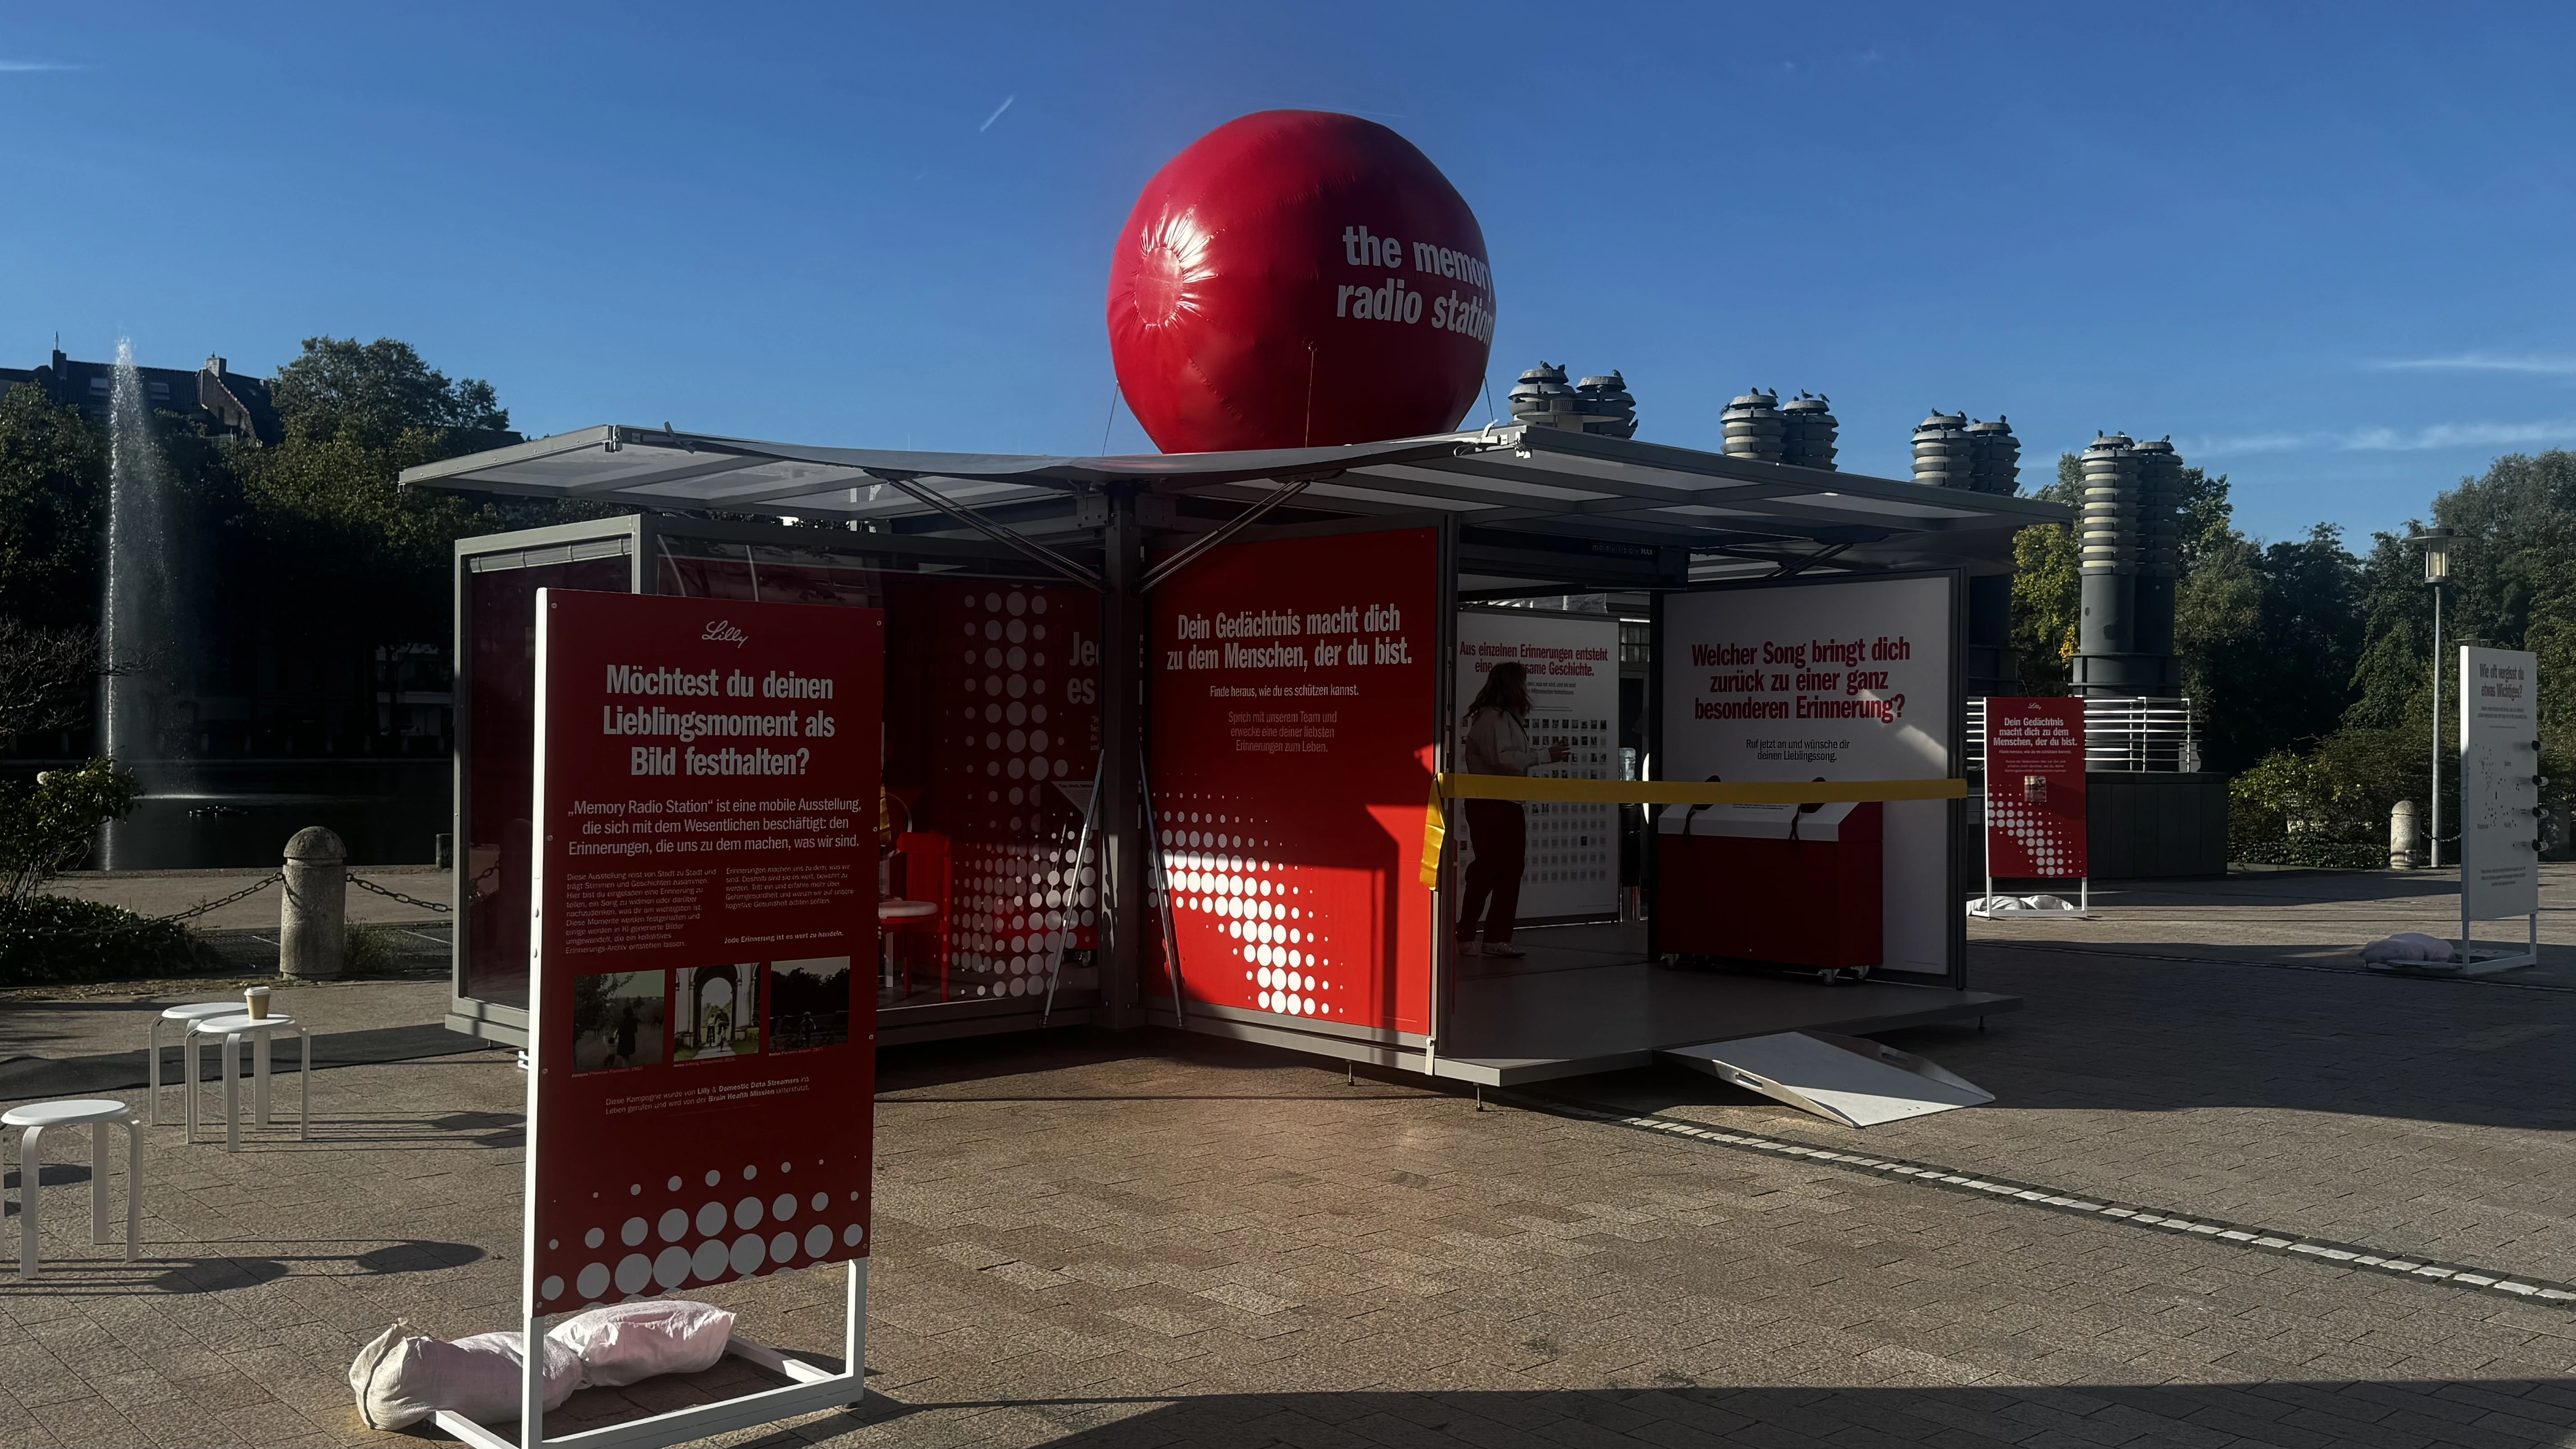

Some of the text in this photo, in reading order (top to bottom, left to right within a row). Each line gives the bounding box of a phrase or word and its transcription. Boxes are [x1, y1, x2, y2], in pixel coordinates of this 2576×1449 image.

[1343, 225, 1402, 268] the
[1337, 278, 1492, 346] radio station
[1178, 603, 1400, 639] Dein Gedächtnis macht dich
[702, 621, 748, 648] Lilly
[1070, 632, 1099, 666] Je
[1167, 637, 1412, 672] zu dem Menschen, der du bist.
[1460, 641, 1608, 662] Aus einzelnen Erinnerungen entsteht
[1692, 636, 1910, 669] Welcher Song bringt dich
[1475, 658, 1492, 675] eine
[1549, 662, 1594, 676] Geschichte.
[607, 665, 833, 699] Möchtest du deinen
[1067, 678, 1095, 704] es
[1211, 684, 1358, 698] Finde heraus, wie du es schützen kannst.
[1710, 667, 1888, 695] zurück zu einer ganz
[1228, 711, 1337, 725] Sprich mit unserem Team und
[1695, 694, 1905, 723] besonderen Erinnerung?
[604, 706, 835, 742] Lieblingsmoment als
[1231, 726, 1334, 737] erwecke eine deiner liebsten
[1999, 727, 2022, 736] macht
[2024, 727, 2039, 736] dich
[2053, 727, 2068, 736] dem
[2005, 718, 2063, 726] Dein Gedächtnis
[1237, 740, 1328, 754] Erinnerungen zum Leben.
[1747, 739, 1758, 748] Ruf
[1760, 740, 1776, 750] jetzt
[1789, 740, 1802, 749] und
[1804, 740, 1837, 749] wünsche
[1840, 740, 1849, 749] dir
[1994, 737, 2077, 747] Menschen, der du bist.
[631, 746, 809, 775] Bild festhalten?
[1758, 750, 1836, 762] deinen Lieblingssong.
[629, 800, 662, 813] Radio
[717, 799, 730, 812] ist
[733, 799, 756, 811] eine
[760, 799, 796, 811] mobile
[798, 798, 861, 812] Ausstellung,
[583, 816, 848, 834] die sich mit dem Wesentlichen beschäftigt: den
[570, 834, 859, 856] Erinnerungen, die uns zu dem machen, was wir sind.
